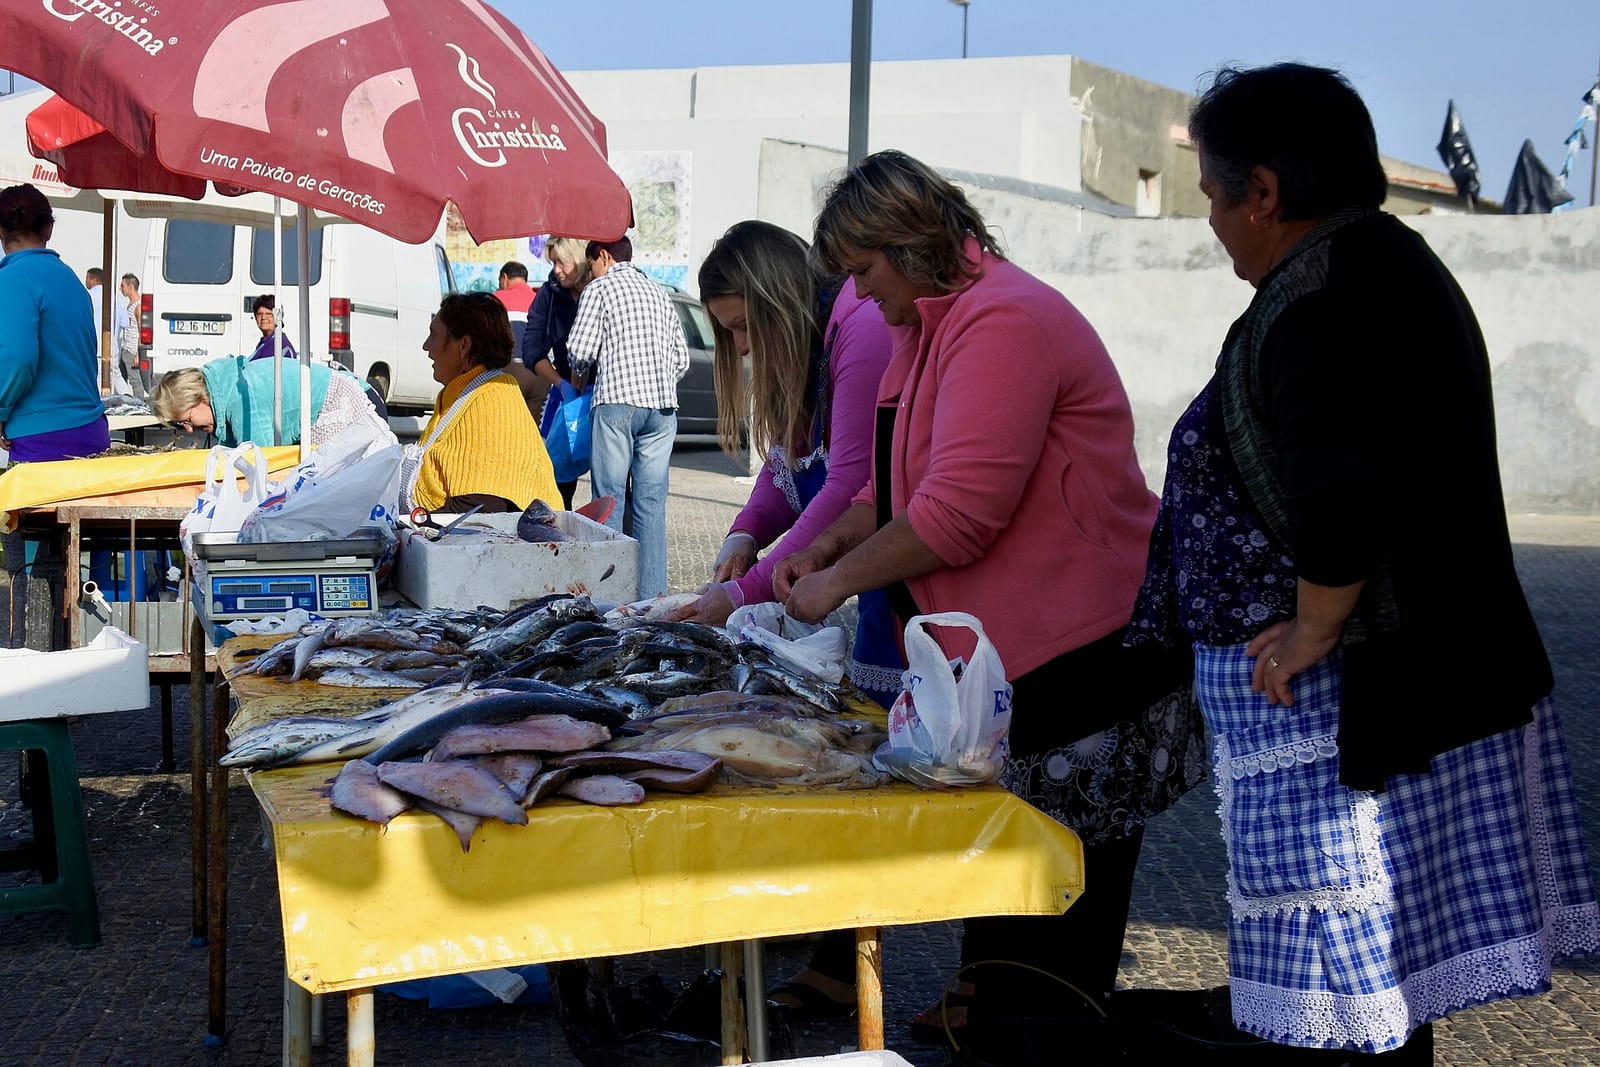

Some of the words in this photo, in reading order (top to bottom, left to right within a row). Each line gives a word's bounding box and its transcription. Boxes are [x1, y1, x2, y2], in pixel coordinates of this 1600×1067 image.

[451, 107, 567, 168] Christina
[200, 147, 239, 169] Uma
[241, 157, 294, 184] Paixão
[296, 174, 317, 191] de
[318, 179, 386, 216] Gerações
[167, 347, 208, 356] CITROËN
